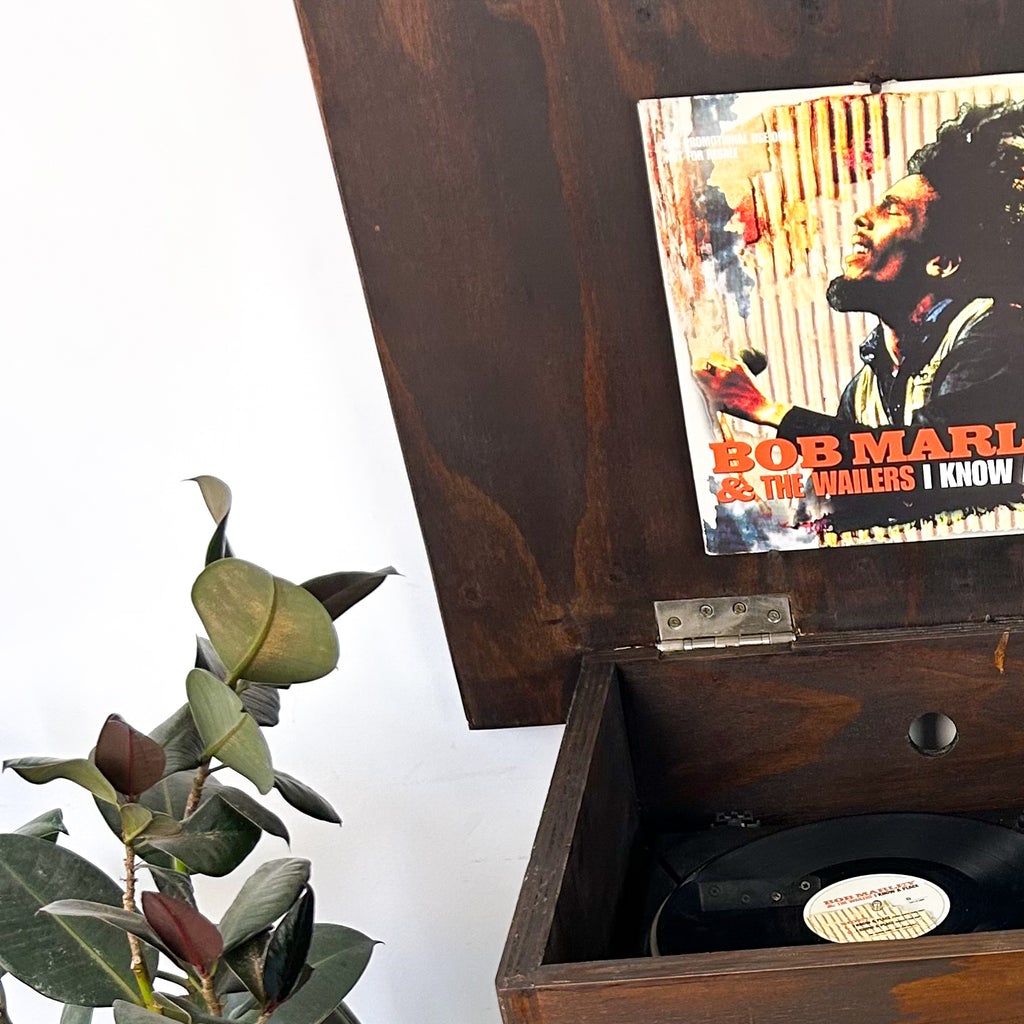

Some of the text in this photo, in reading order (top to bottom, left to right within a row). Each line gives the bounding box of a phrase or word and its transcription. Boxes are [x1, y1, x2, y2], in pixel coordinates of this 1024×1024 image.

[709, 435, 843, 474] BOB
[716, 476, 756, 503] &
[760, 473, 805, 500] THE
[811, 465, 916, 497] WAILERS
[922, 463, 933, 490] I
[939, 457, 1014, 488] KNOW
[823, 880, 916, 905] BOB MARLEY
[902, 883, 919, 891] PLACE
